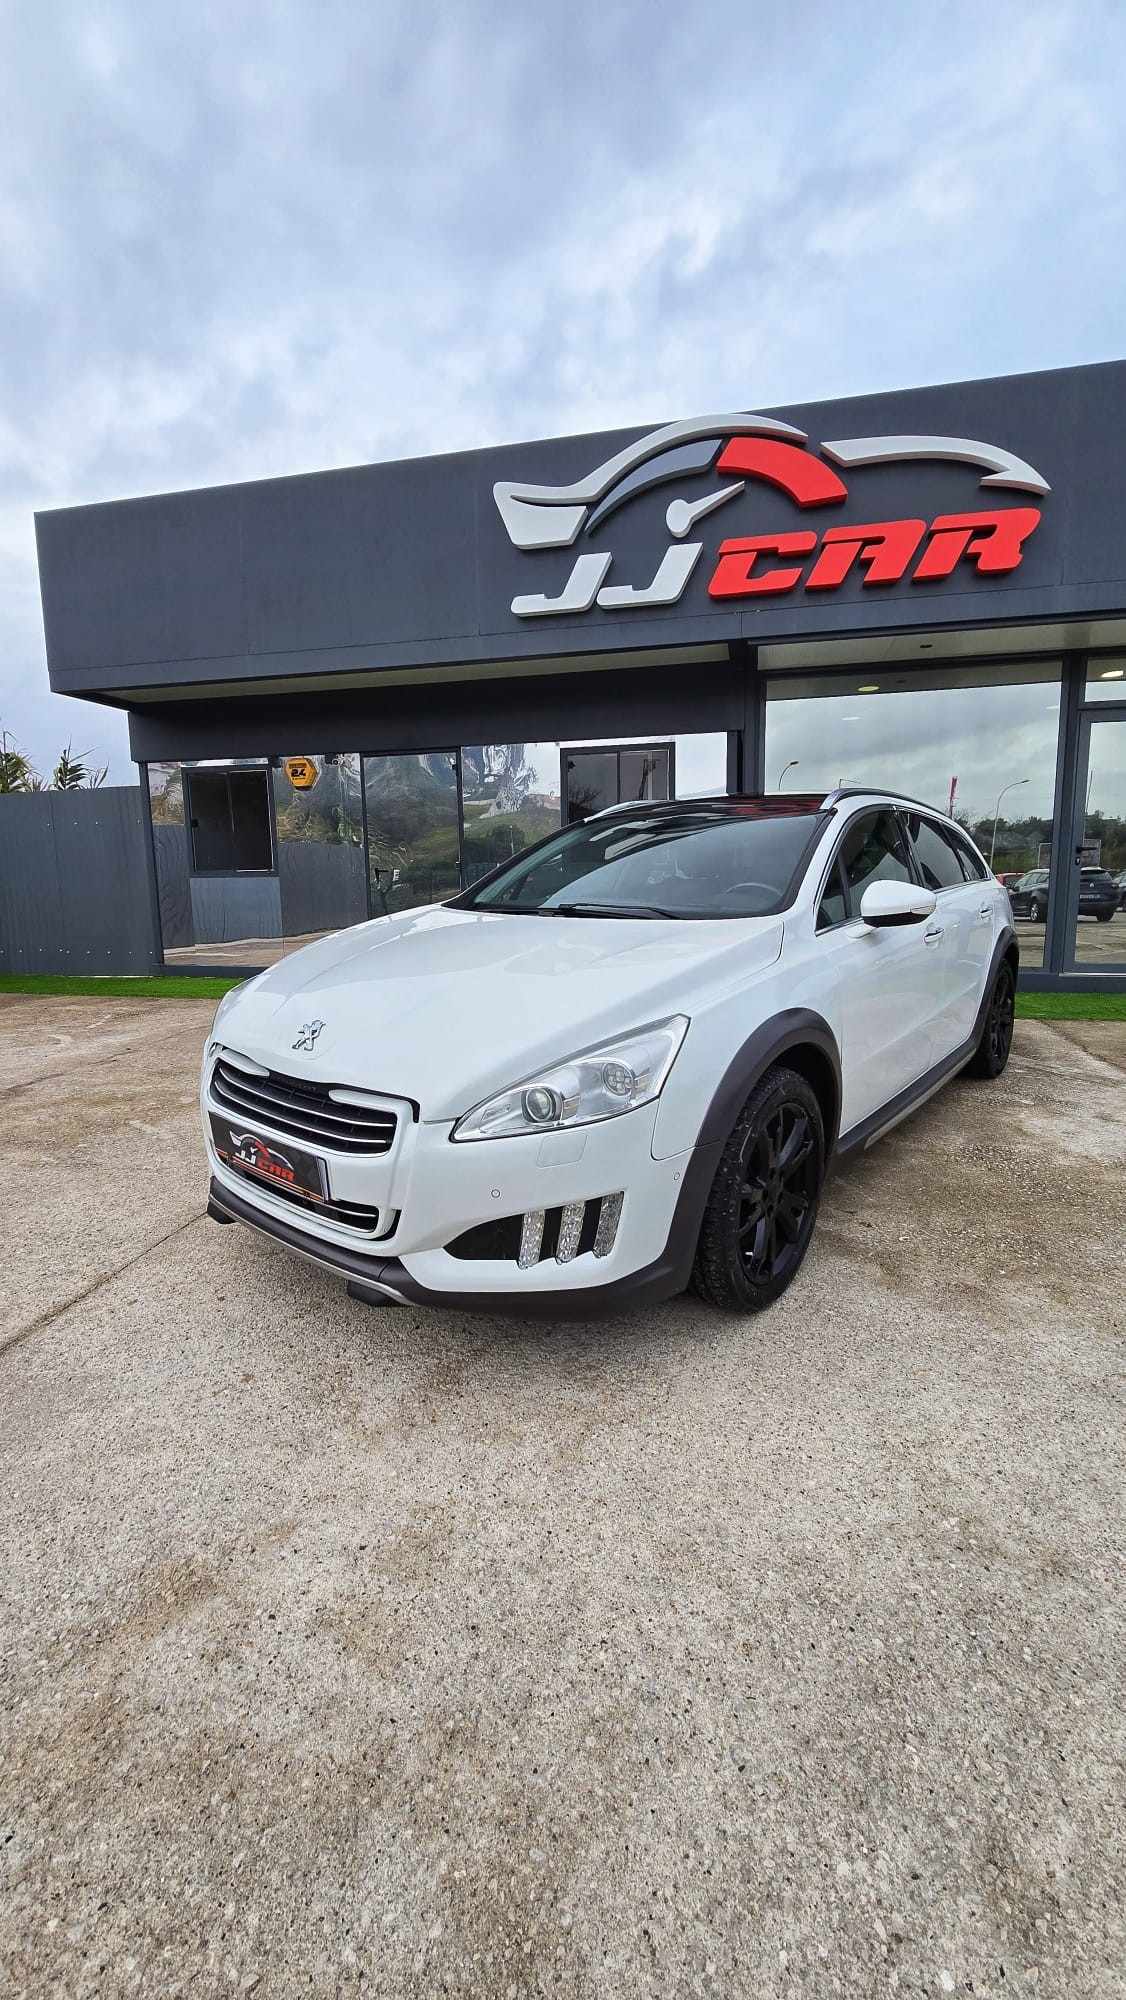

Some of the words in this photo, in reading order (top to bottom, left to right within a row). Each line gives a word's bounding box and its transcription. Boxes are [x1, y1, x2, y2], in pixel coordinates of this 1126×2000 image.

[511, 542, 703, 616] JJ
[708, 507, 1041, 599] CAR
[256, 1158, 295, 1182] CAR
